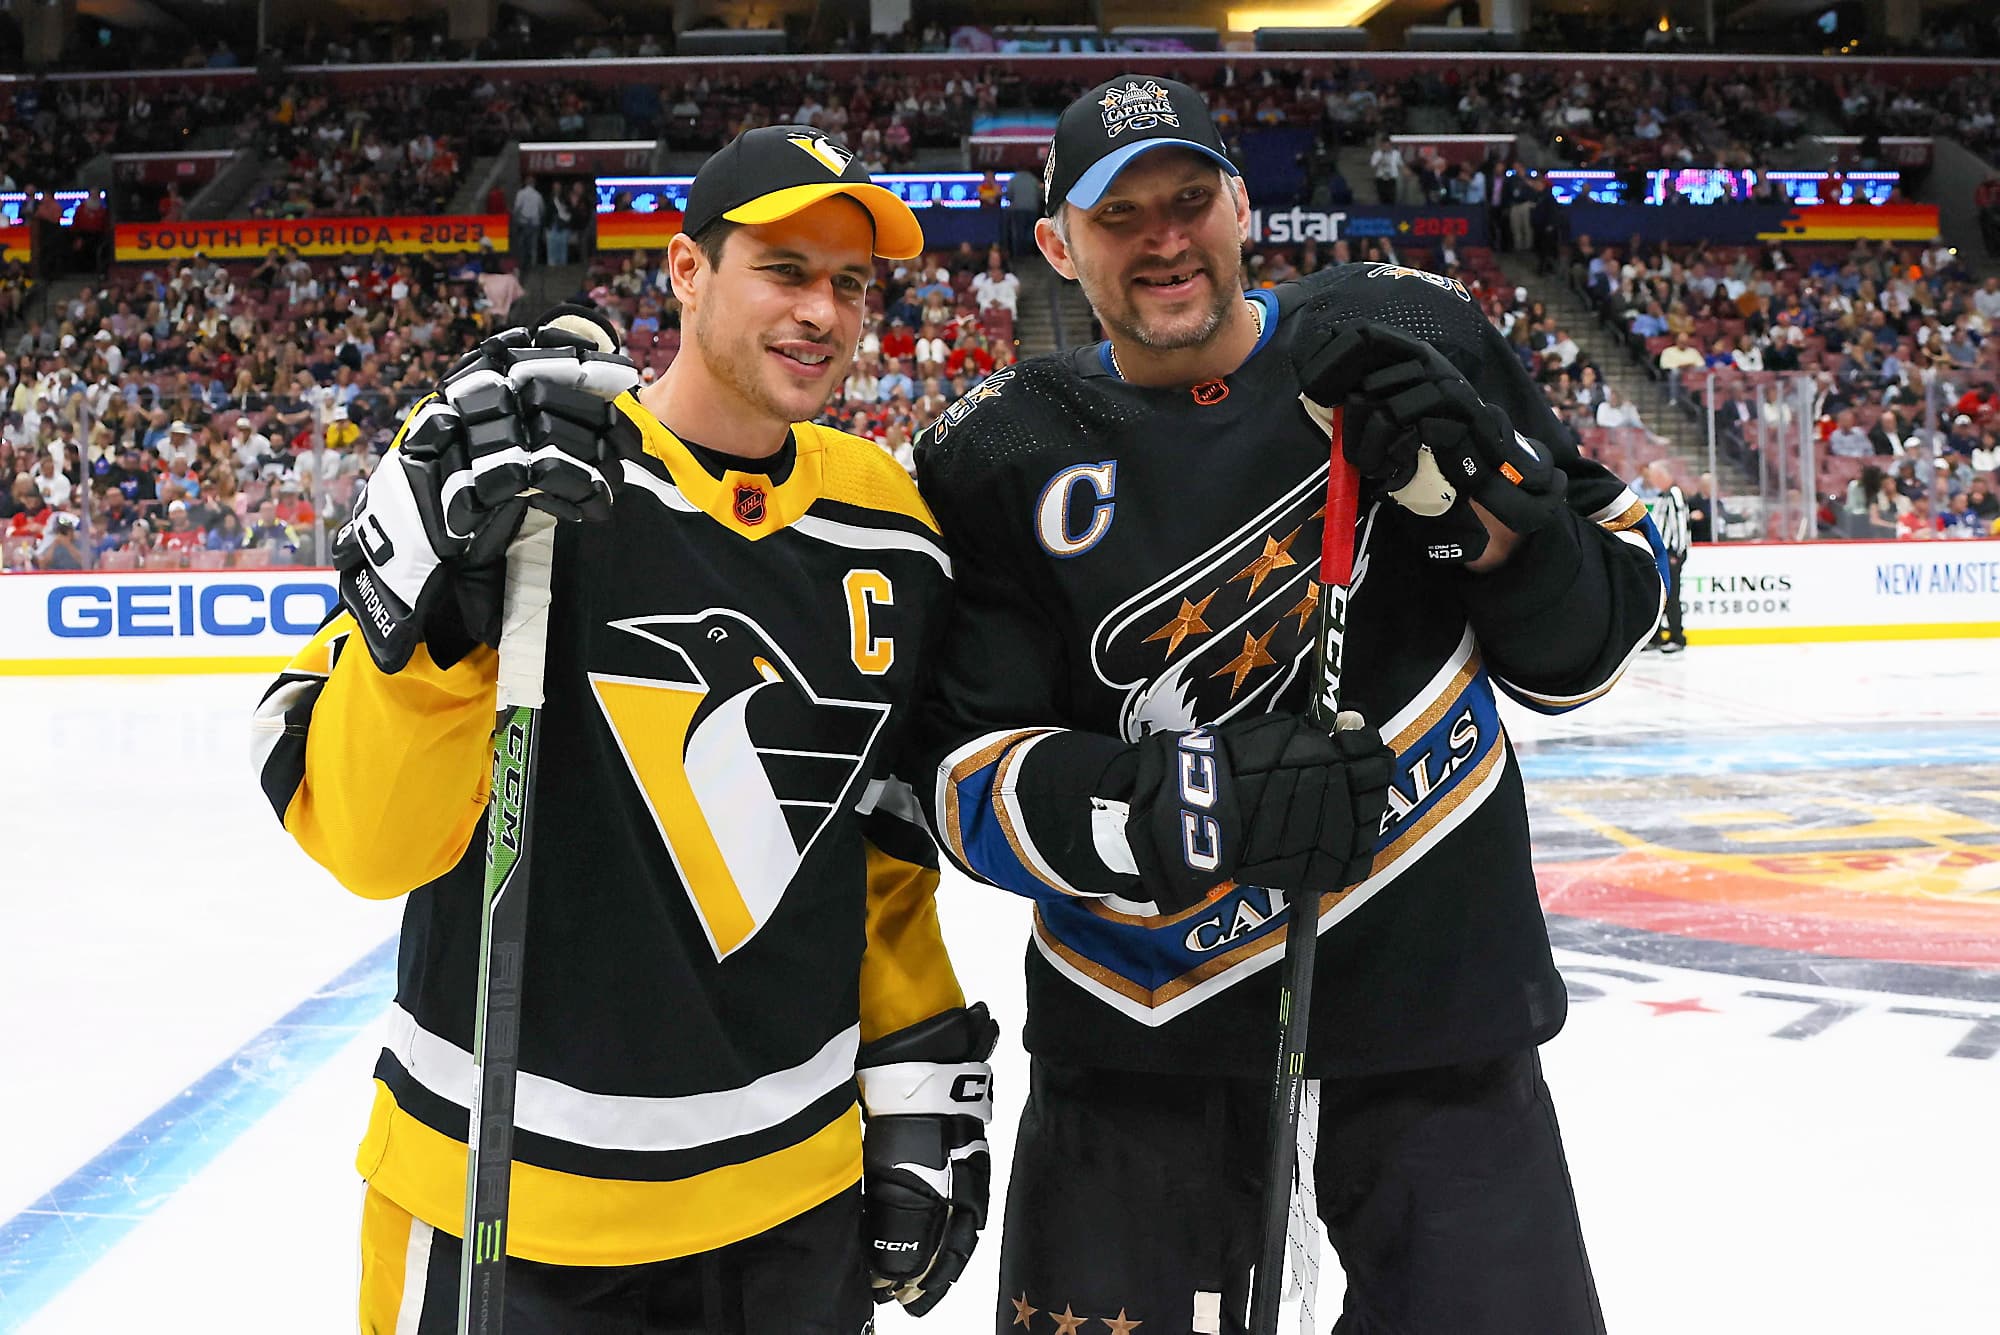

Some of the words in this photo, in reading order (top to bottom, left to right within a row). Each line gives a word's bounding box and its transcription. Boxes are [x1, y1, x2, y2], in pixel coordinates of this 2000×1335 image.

[1107, 101, 1172, 121] CAPITALS
[137, 229, 241, 250] SOUTH
[257, 226, 394, 246] FLORIDA
[419, 223, 485, 243] 2023
[1269, 206, 1346, 242] star
[740, 495, 760, 514] NHL
[1033, 459, 1118, 559] C
[1428, 548, 1463, 559] CCM
[1876, 563, 1922, 595] NEW
[1929, 562, 2000, 593] AMSTE
[47, 583, 339, 638] GEICO
[355, 568, 397, 639] PENGUINS
[842, 569, 894, 675] C
[1322, 584, 1348, 714] CCM
[501, 722, 526, 852] CCM
[1289, 1077, 1298, 1114] TRIGGER
[873, 1240, 920, 1252] CCM
